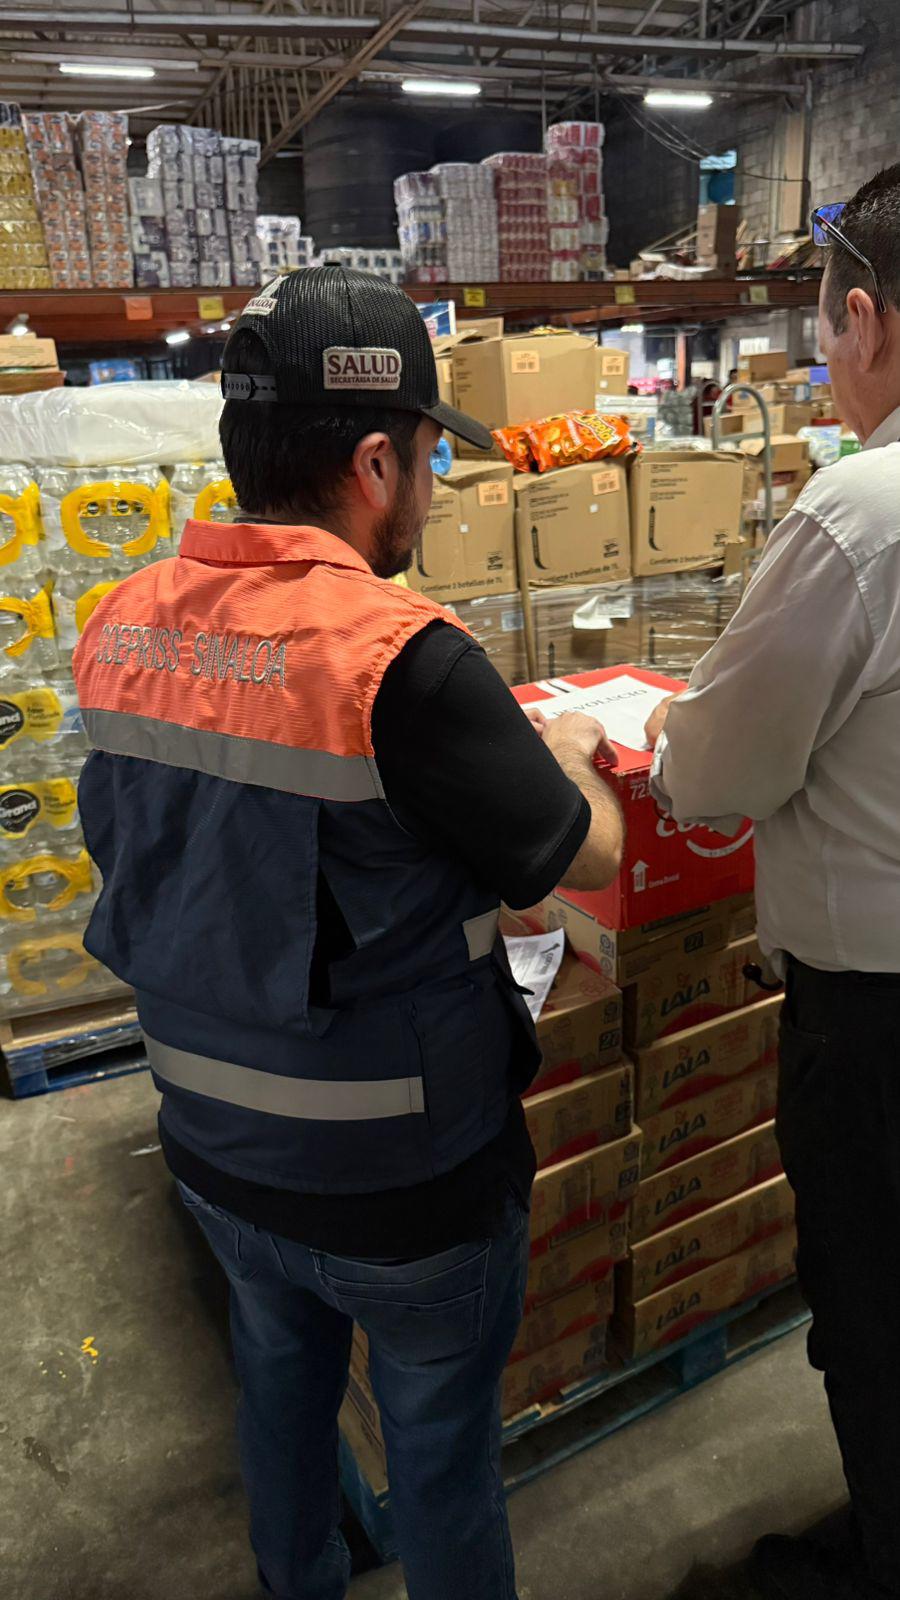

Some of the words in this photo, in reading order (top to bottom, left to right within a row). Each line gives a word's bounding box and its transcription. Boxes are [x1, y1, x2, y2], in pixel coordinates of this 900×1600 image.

[328, 355, 399, 375] SALUD
[191, 632, 287, 688] SINALOA
[661, 978, 710, 1017] LALA
[662, 1049, 710, 1089] LALA
[659, 1113, 706, 1153] LALA
[655, 1176, 702, 1215] LALA
[655, 1238, 700, 1275] LALA
[656, 1292, 700, 1330] LALA
